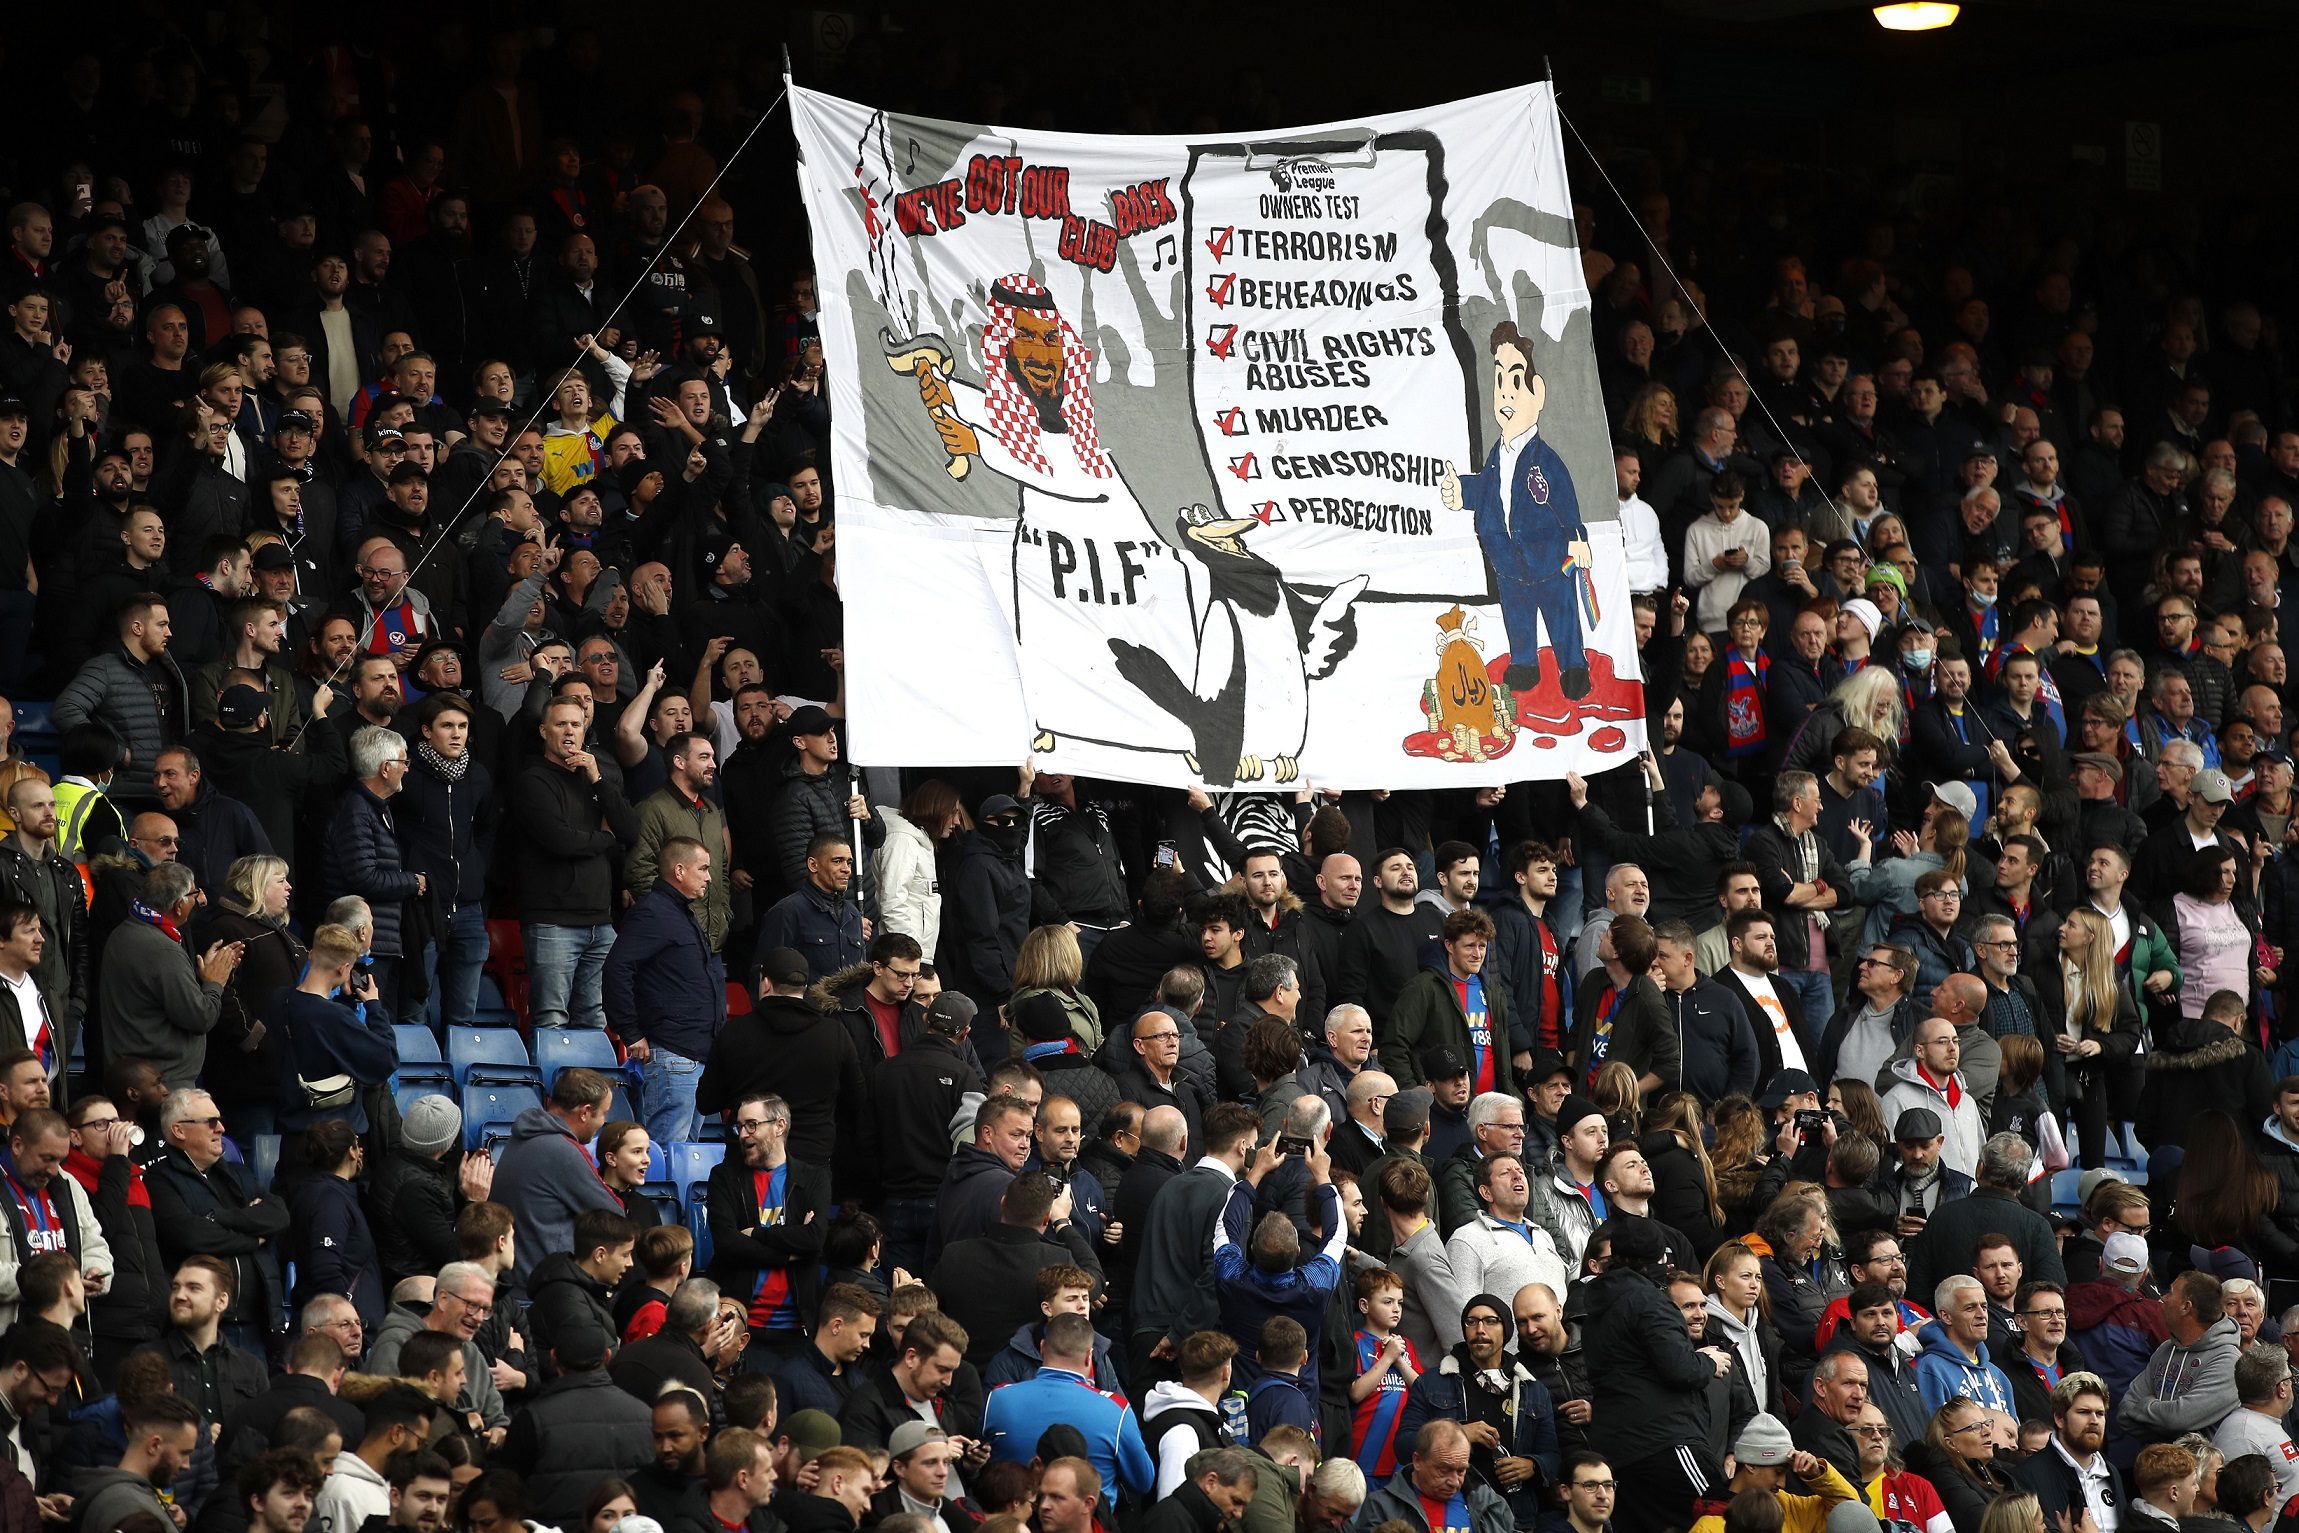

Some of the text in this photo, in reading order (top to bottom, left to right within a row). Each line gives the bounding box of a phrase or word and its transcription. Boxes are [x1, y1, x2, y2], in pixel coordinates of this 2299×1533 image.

[1291, 162, 1333, 174] Premier
[1294, 176, 1335, 192] League
[895, 154, 1177, 273] WE'VE GOT OUR CLUB BACK
[1260, 194, 1360, 219] OWNERS TEST
[1238, 229, 1397, 262] TERRORISM
[1240, 273, 1418, 310] BEHEADINGS
[1242, 326, 1436, 365] CIVIL RIGHTS
[1246, 360, 1371, 391] ABUSES
[1255, 404, 1389, 434] MURDER
[1271, 450, 1445, 487] CENSORSHIP
[1288, 497, 1433, 536] PERSECUTION
